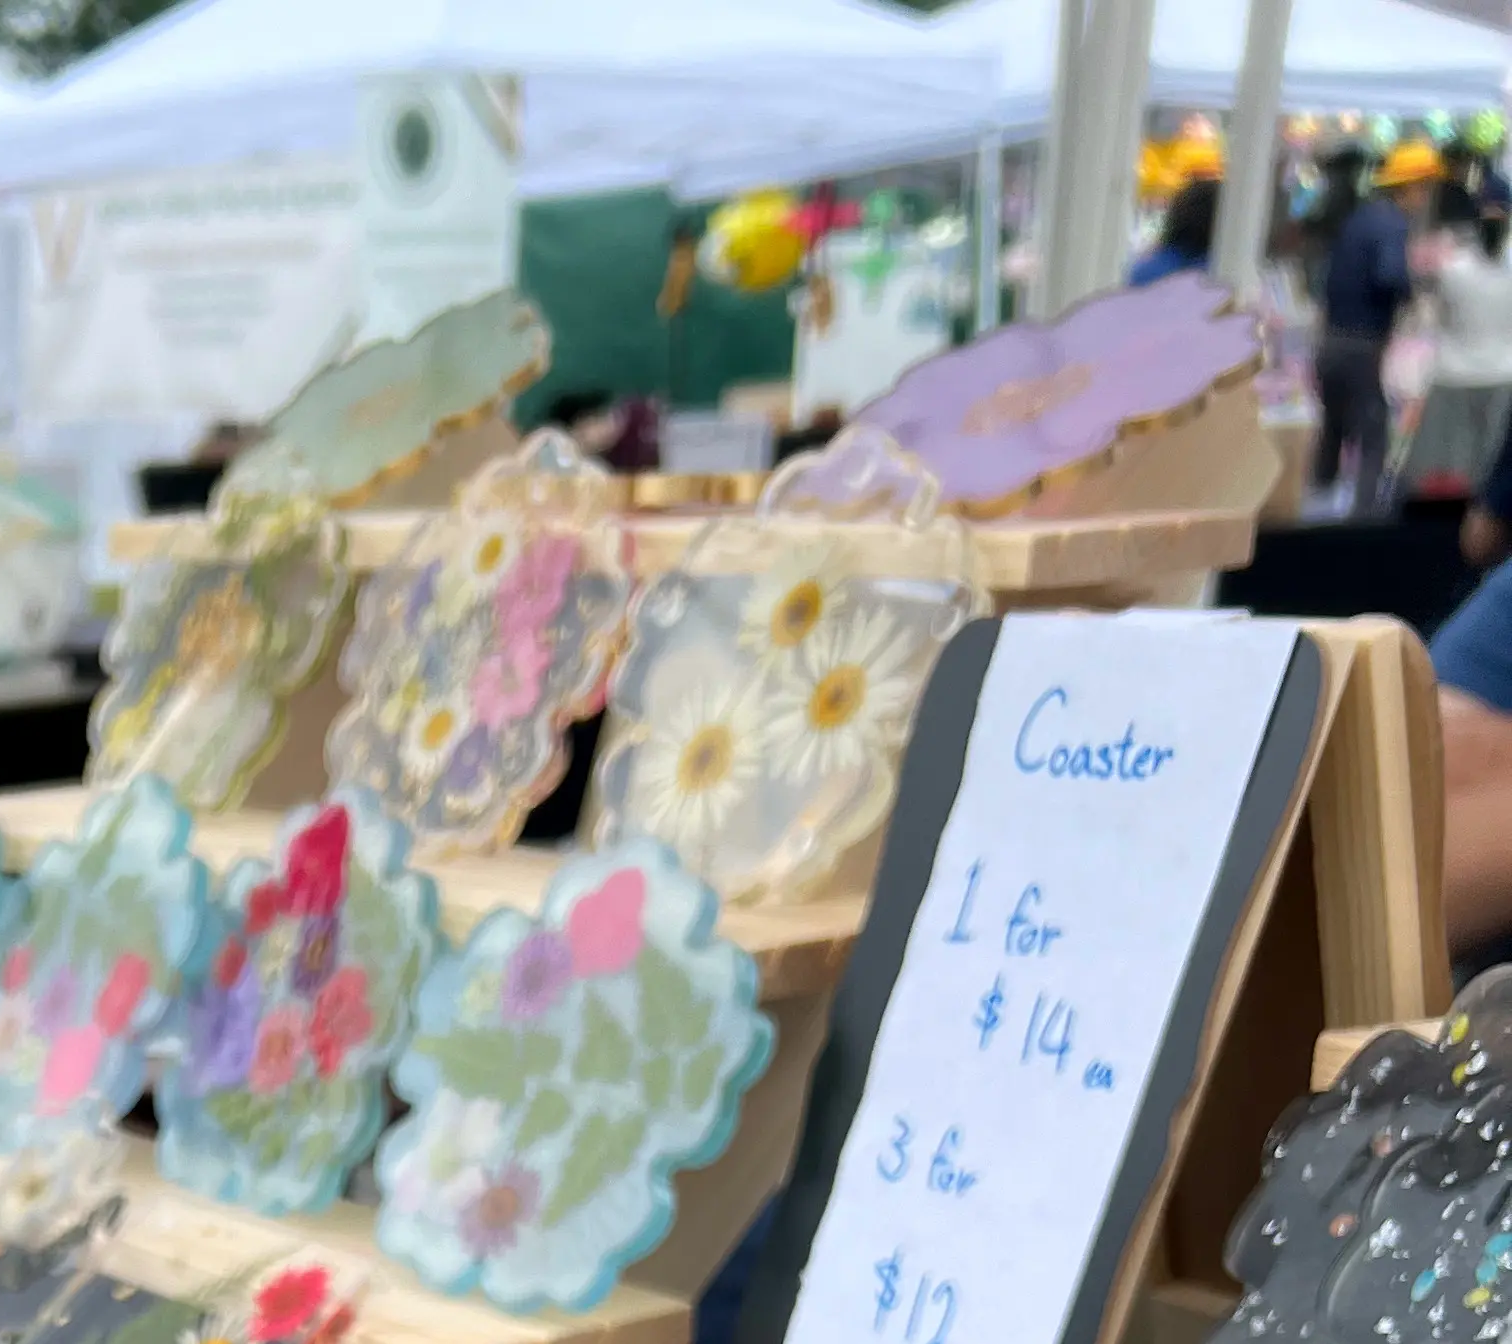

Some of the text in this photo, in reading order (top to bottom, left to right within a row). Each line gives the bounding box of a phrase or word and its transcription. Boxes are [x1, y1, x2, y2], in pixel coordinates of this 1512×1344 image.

[1014, 685, 1175, 781] Coaster
[944, 855, 1064, 957] 1 for
[1082, 1058, 1115, 1091] ea
[876, 1112, 979, 1197] 3 for
